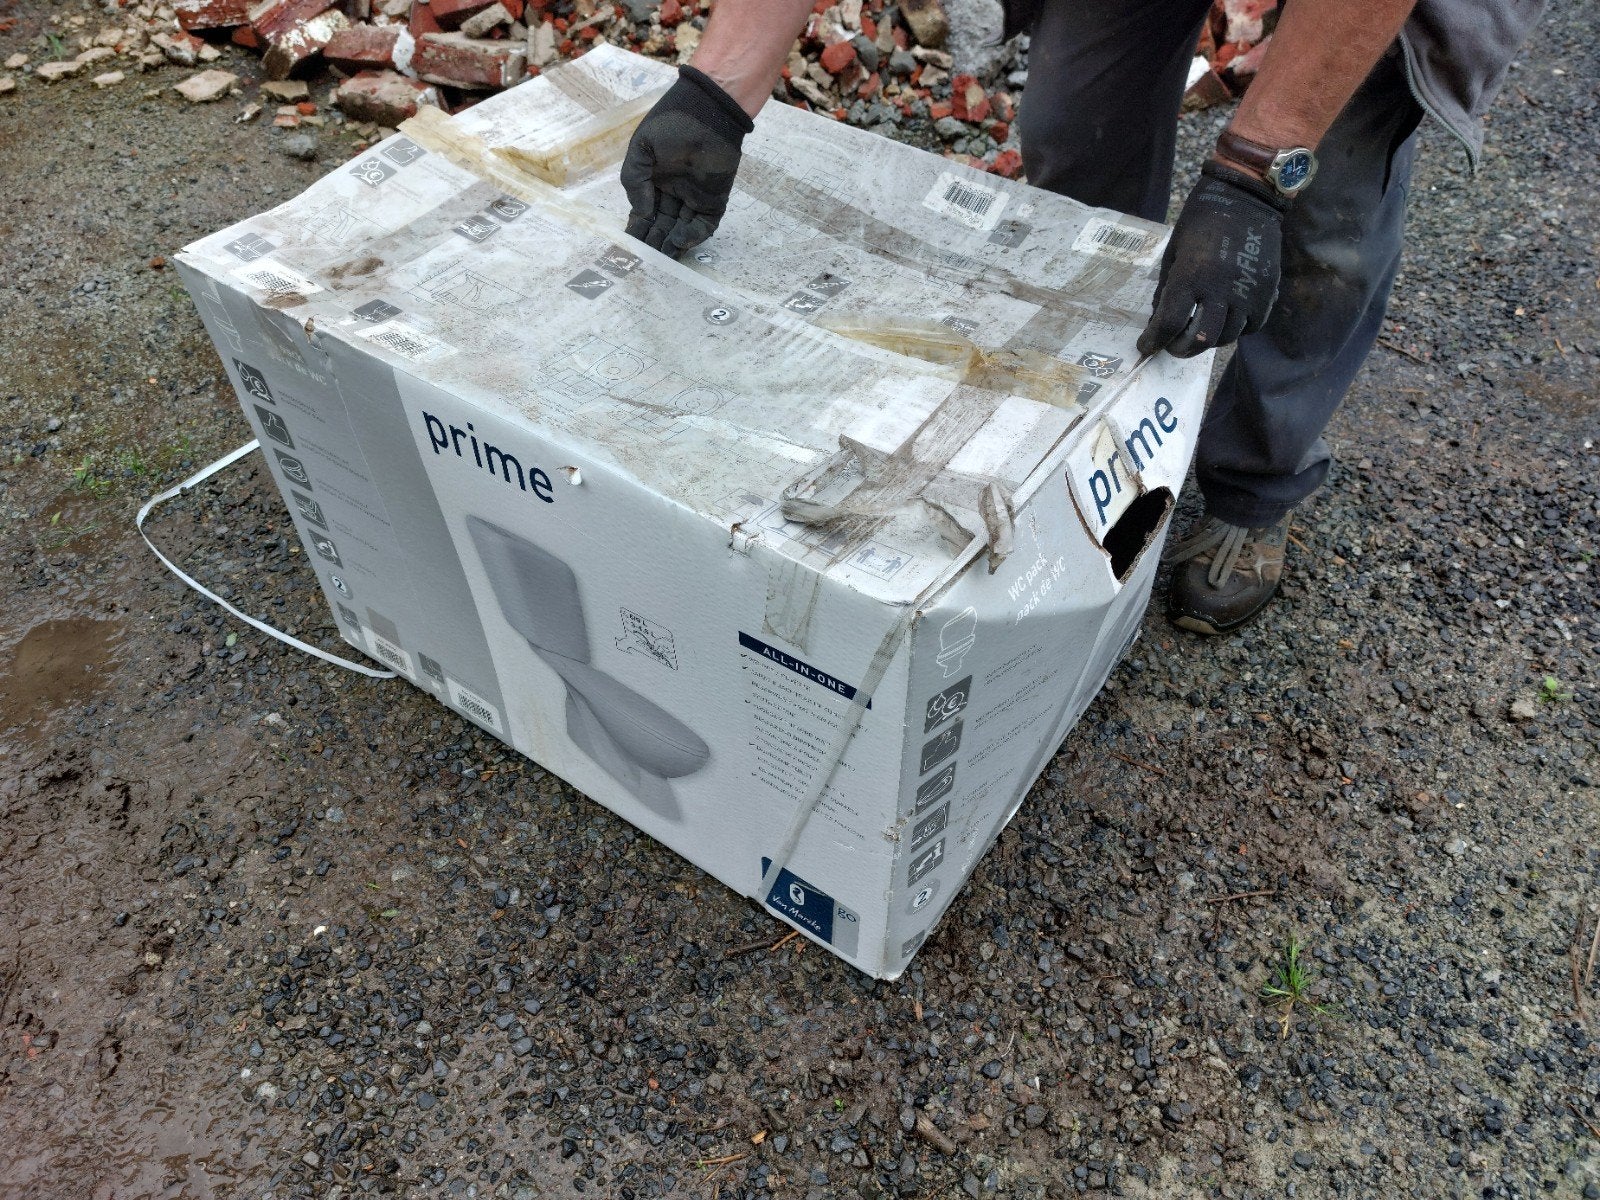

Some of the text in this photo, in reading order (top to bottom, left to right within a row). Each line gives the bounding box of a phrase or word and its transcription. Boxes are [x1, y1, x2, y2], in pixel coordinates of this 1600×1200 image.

[1232, 234, 1262, 300] HyFlex
[422, 410, 555, 504] prime
[1088, 396, 1178, 526] prme
[1008, 553, 1048, 602] WC pack
[763, 647, 848, 695] ALL-IN-ONE
[772, 895, 788, 911] Van
